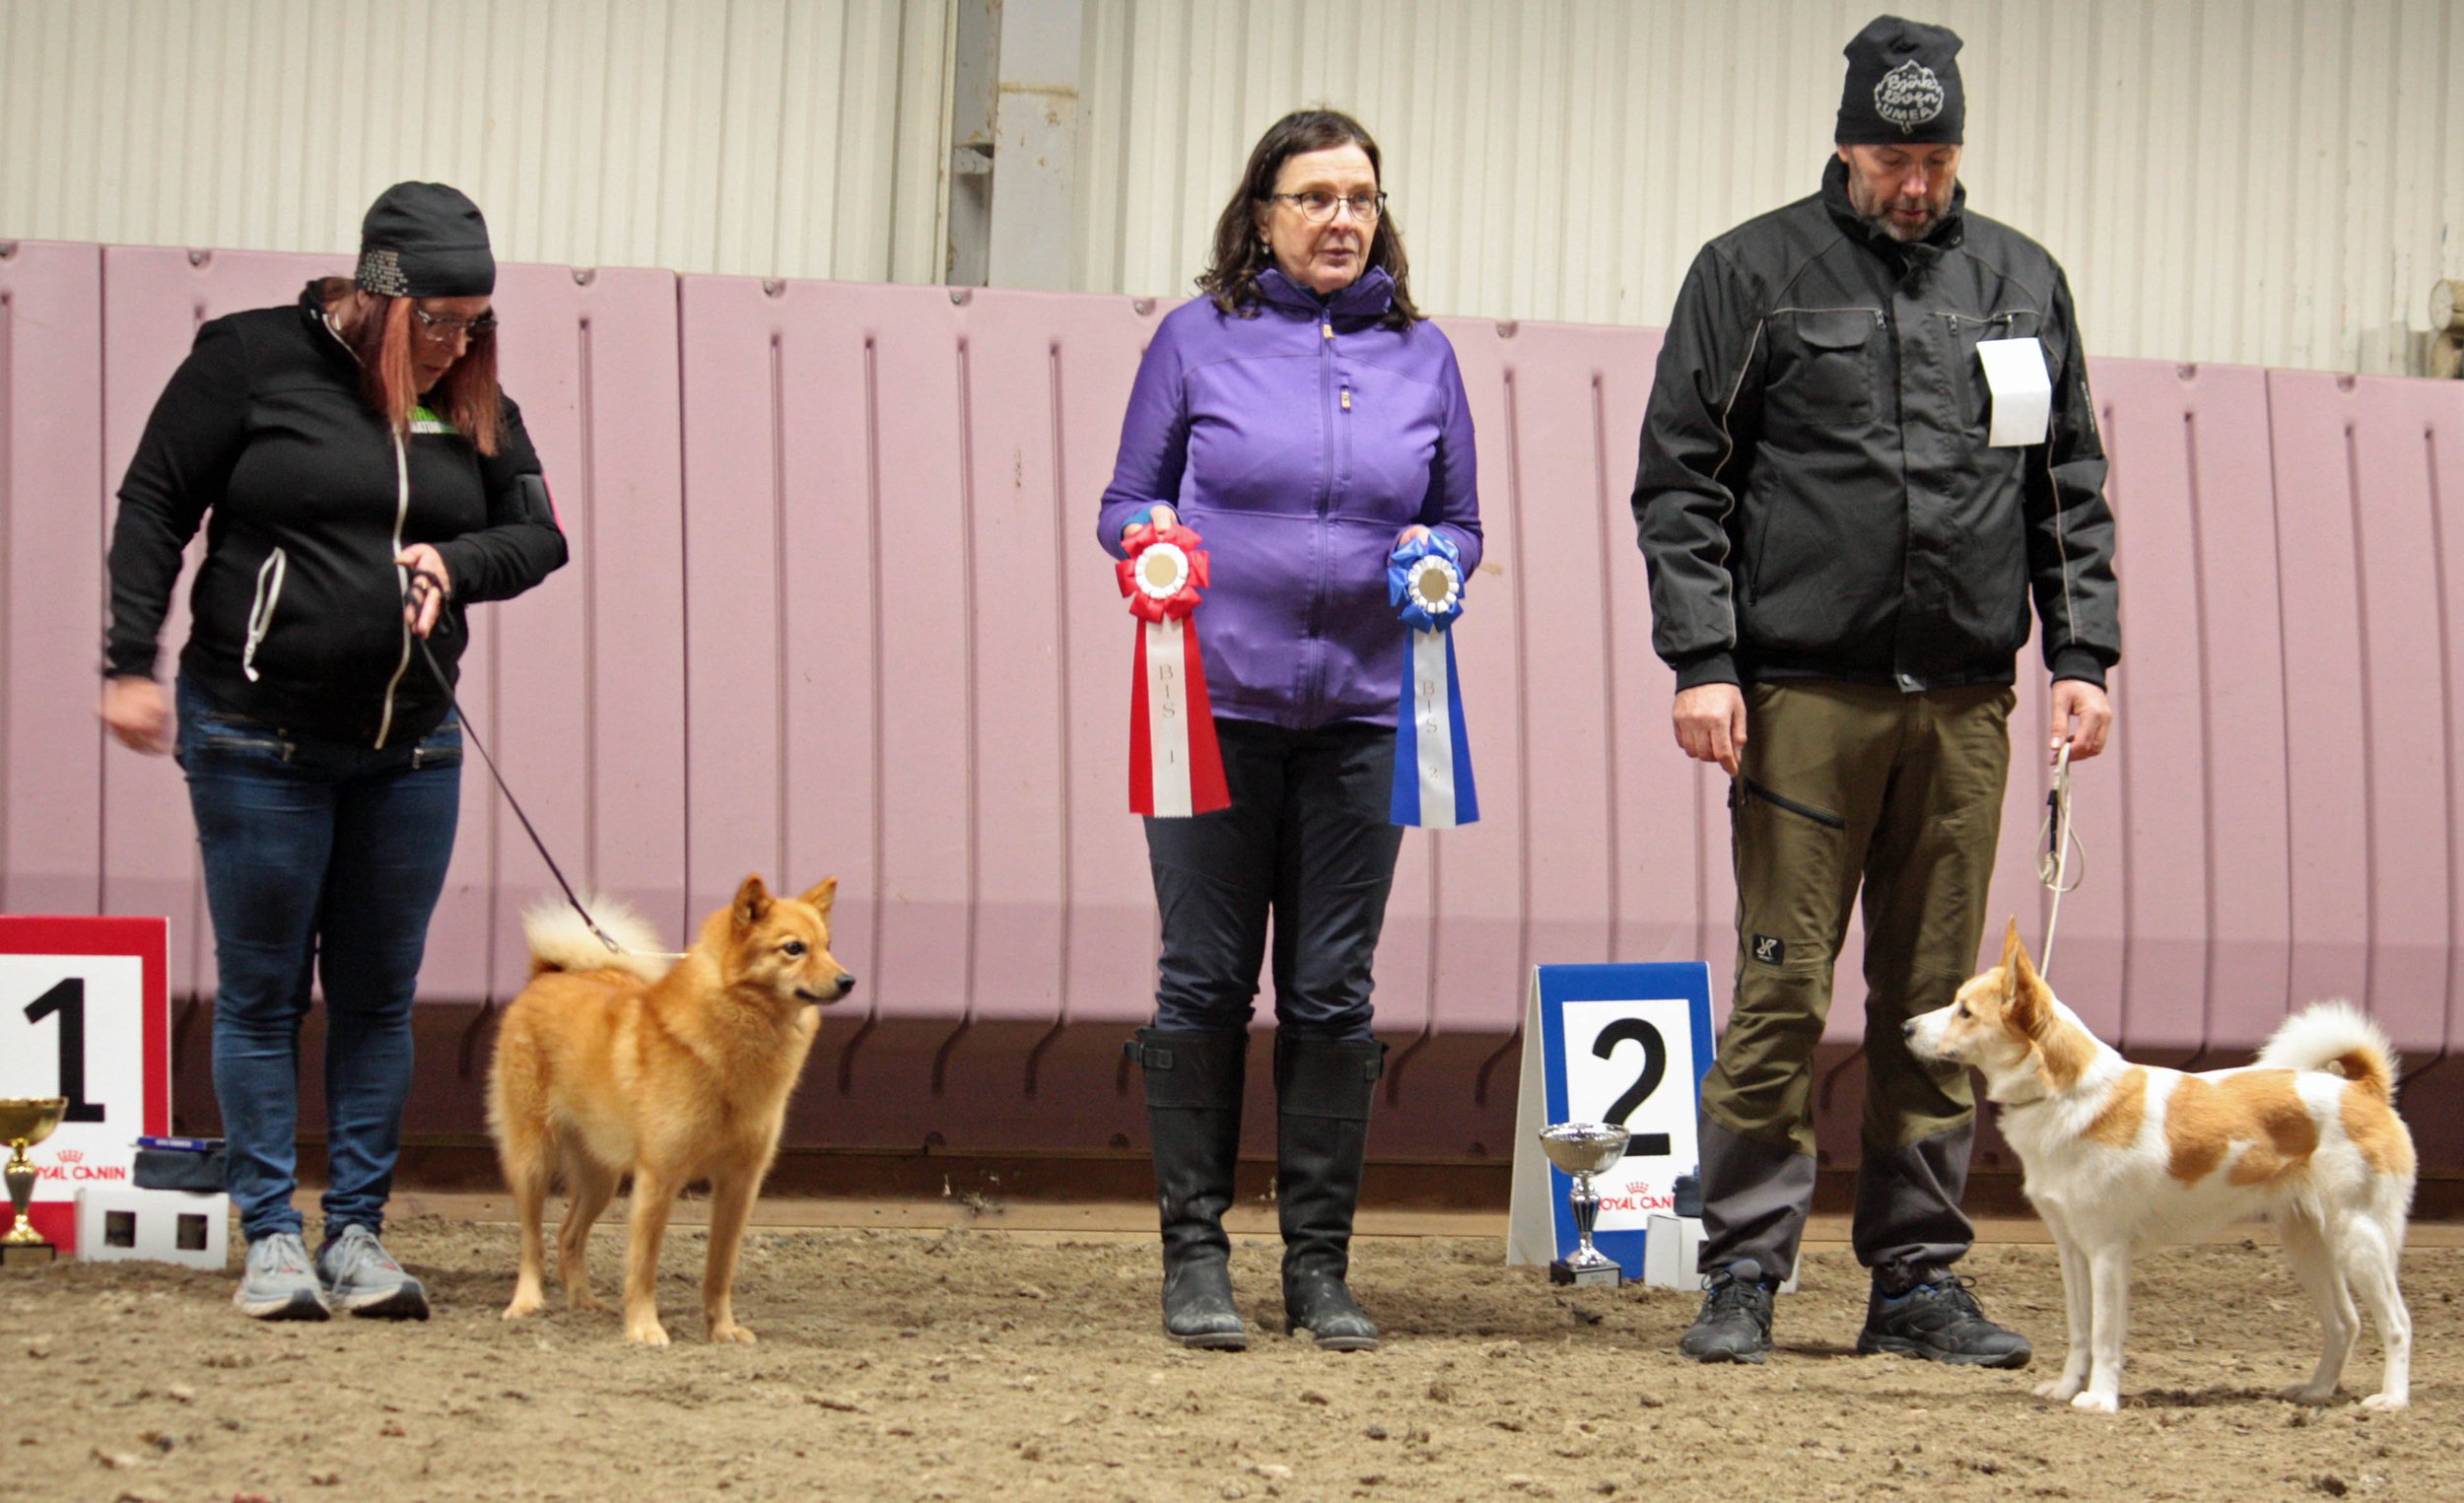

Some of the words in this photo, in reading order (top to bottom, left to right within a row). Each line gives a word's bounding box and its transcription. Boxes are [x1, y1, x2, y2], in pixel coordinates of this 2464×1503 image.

[23, 978, 105, 1123] 1
[1592, 1017, 1672, 1157] 2
[35, 1166, 68, 1180] YAL
[72, 1166, 126, 1180] CANIN
[1598, 1197, 1636, 1211] OYAL
